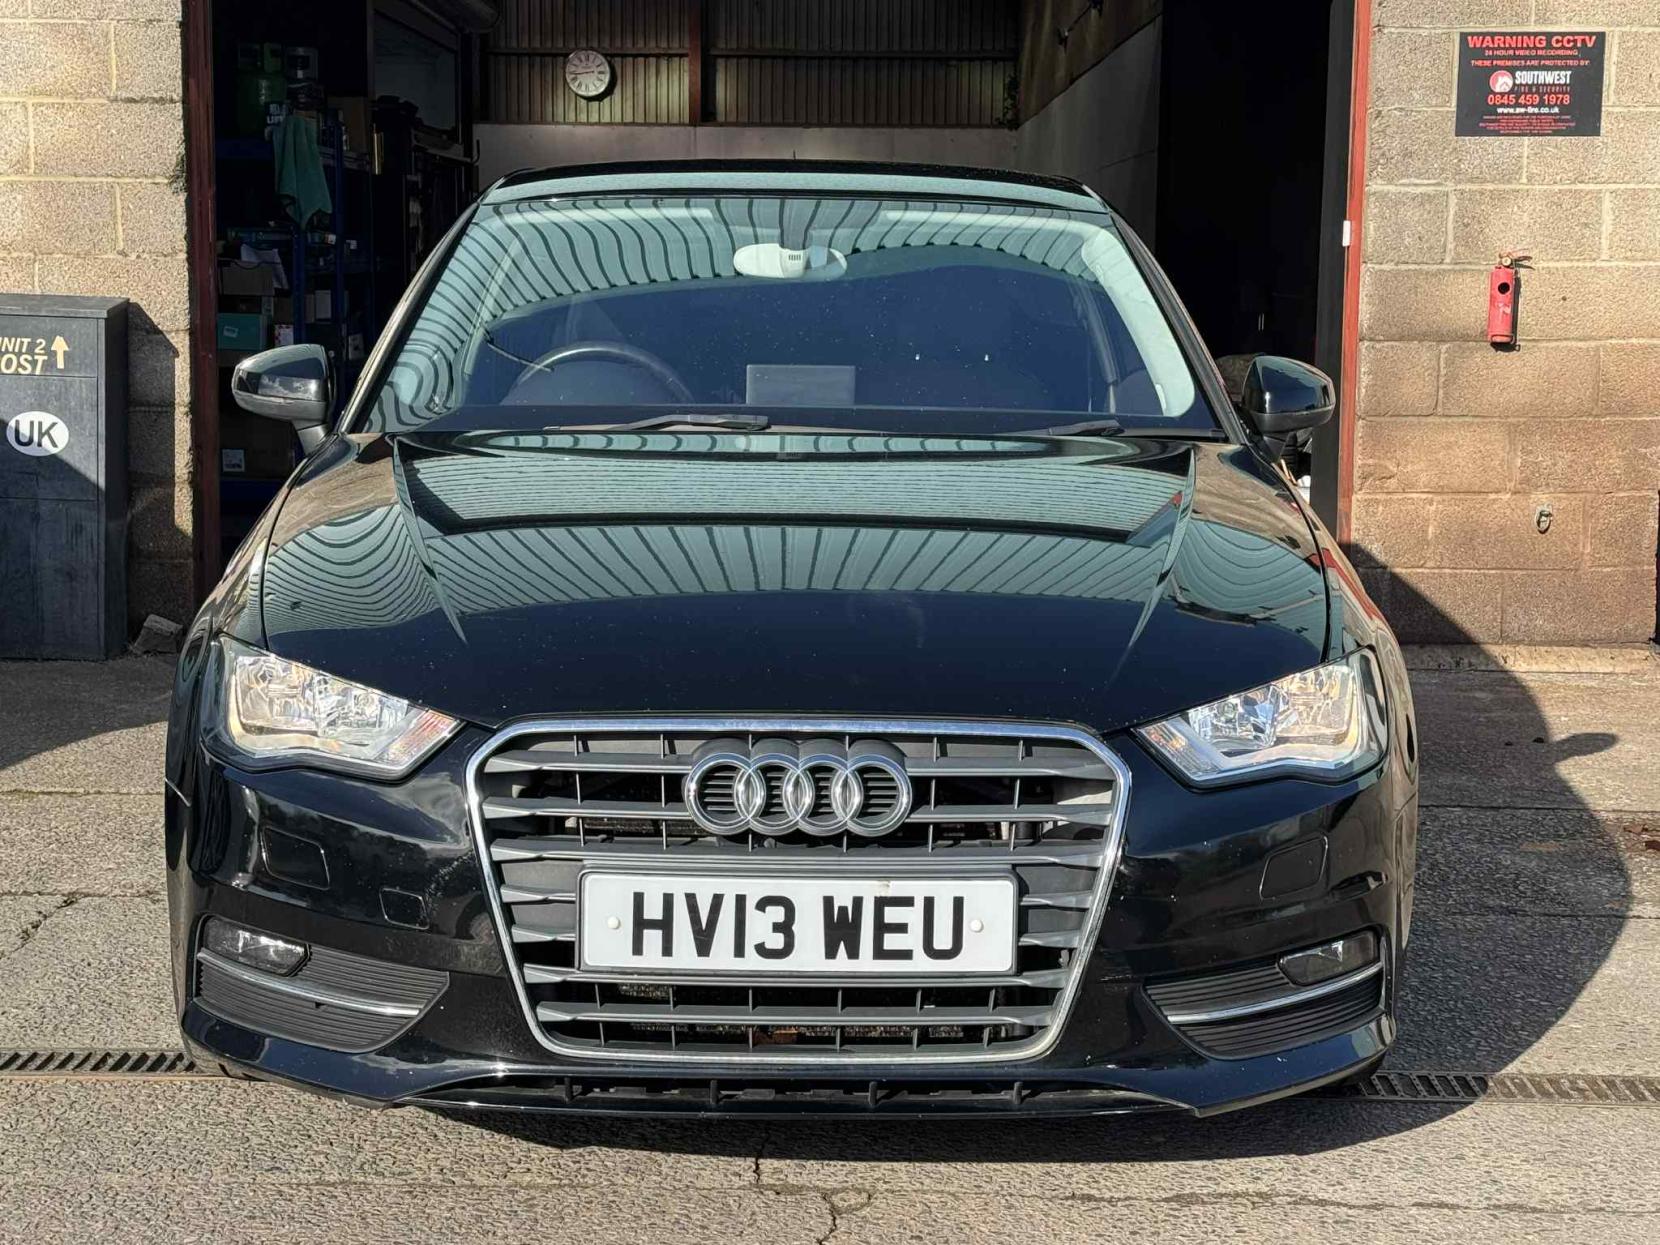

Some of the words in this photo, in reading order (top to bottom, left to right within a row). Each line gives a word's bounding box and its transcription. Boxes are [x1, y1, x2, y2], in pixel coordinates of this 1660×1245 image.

[1467, 35, 1546, 48] WARNING
[1551, 35, 1596, 48] CCTV
[1515, 70, 1572, 84] SOUTHWEST
[1487, 94, 1515, 105] 0845
[1518, 94, 1540, 105] 459
[1543, 94, 1571, 105] 1978
[0, 337, 31, 353] NIT
[35, 338, 46, 354] 2
[0, 354, 48, 375] OST
[14, 419, 58, 448] UK
[631, 891, 796, 960] HV13
[822, 895, 965, 960] WEU
